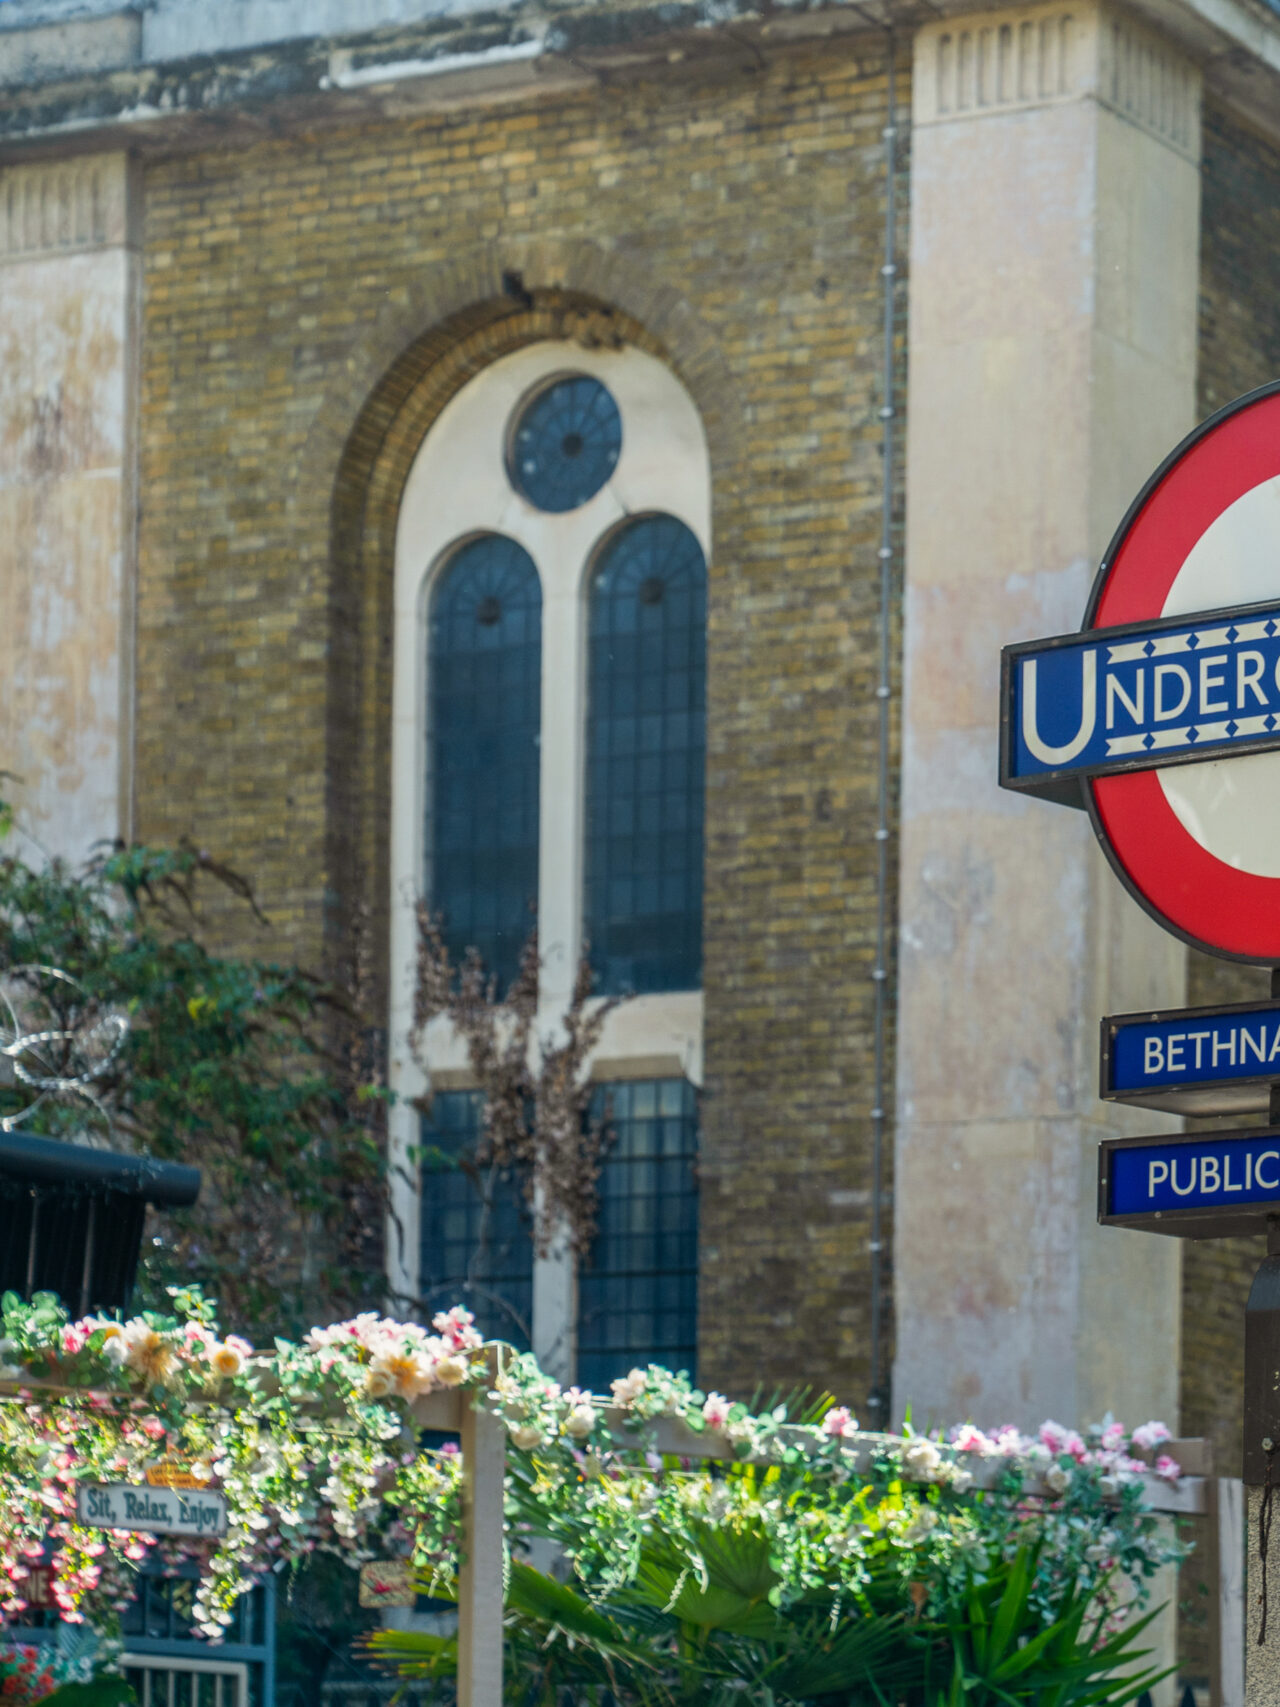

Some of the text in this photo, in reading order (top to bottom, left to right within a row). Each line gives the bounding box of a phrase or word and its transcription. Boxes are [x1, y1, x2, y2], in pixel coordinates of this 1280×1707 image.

[1147, 1150, 1280, 1198] PUBLIC
[87, 1488, 219, 1532] Sit, Relax, Enjoy
